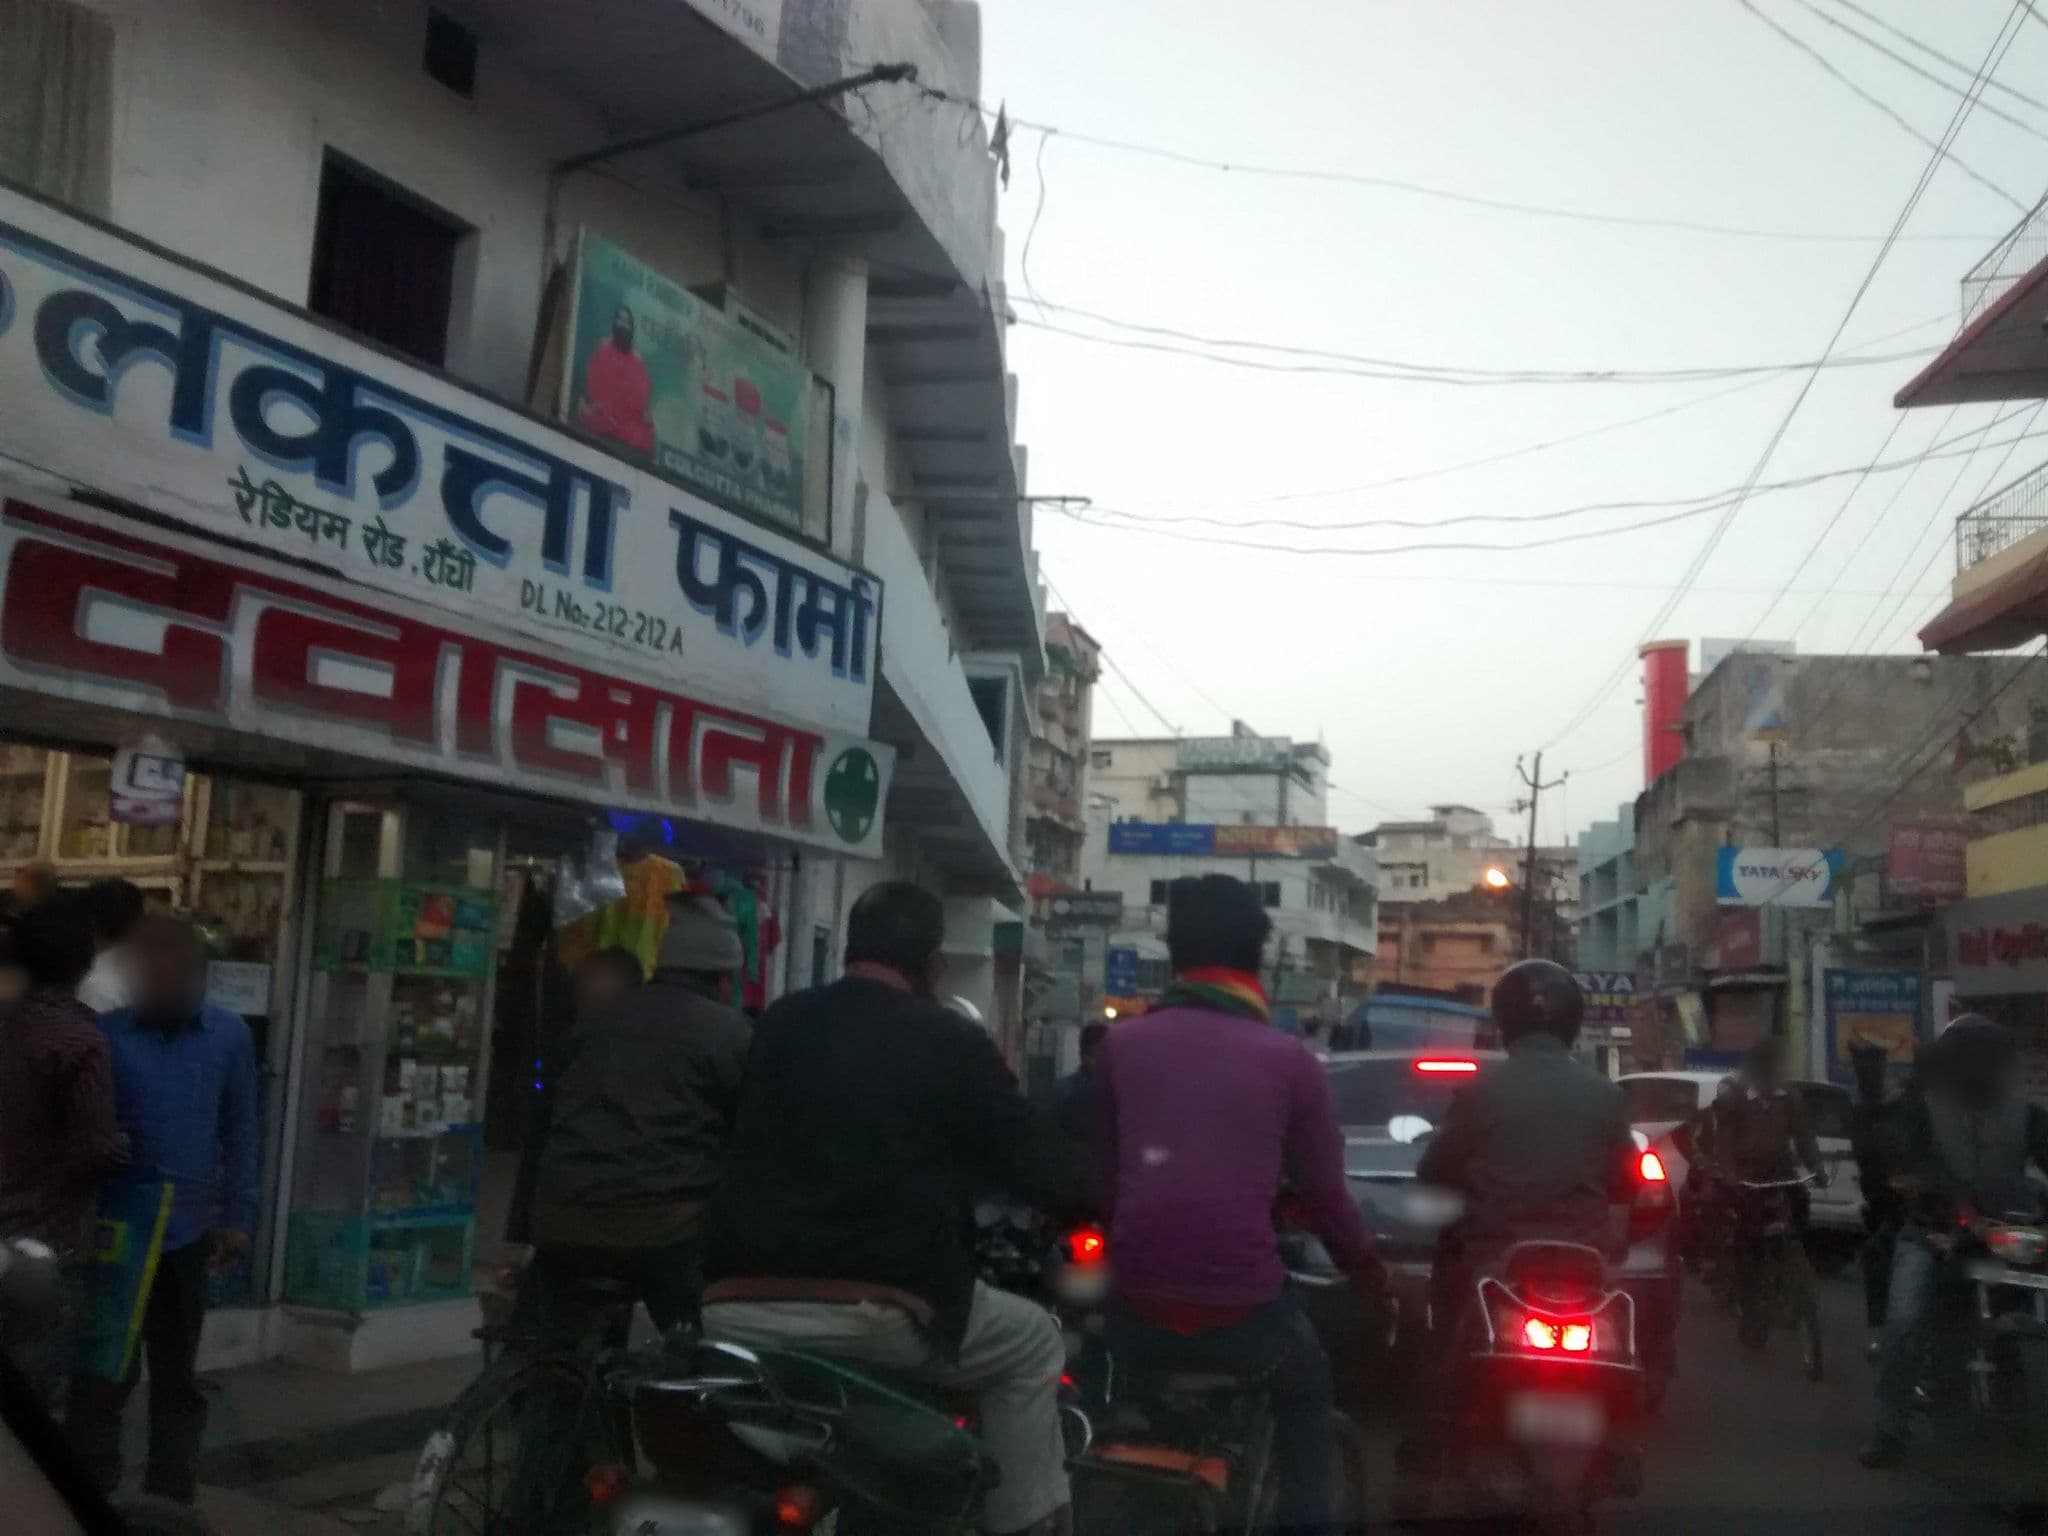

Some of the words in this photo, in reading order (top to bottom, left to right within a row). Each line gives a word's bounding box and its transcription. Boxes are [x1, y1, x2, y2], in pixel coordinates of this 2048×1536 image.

[228, 464, 352, 550] रेडियम
[520, 578, 547, 616] DL
[669, 508, 875, 684] फार्मा
[3, 496, 823, 832] दवाखाना
[1739, 865, 1780, 879] TATA
